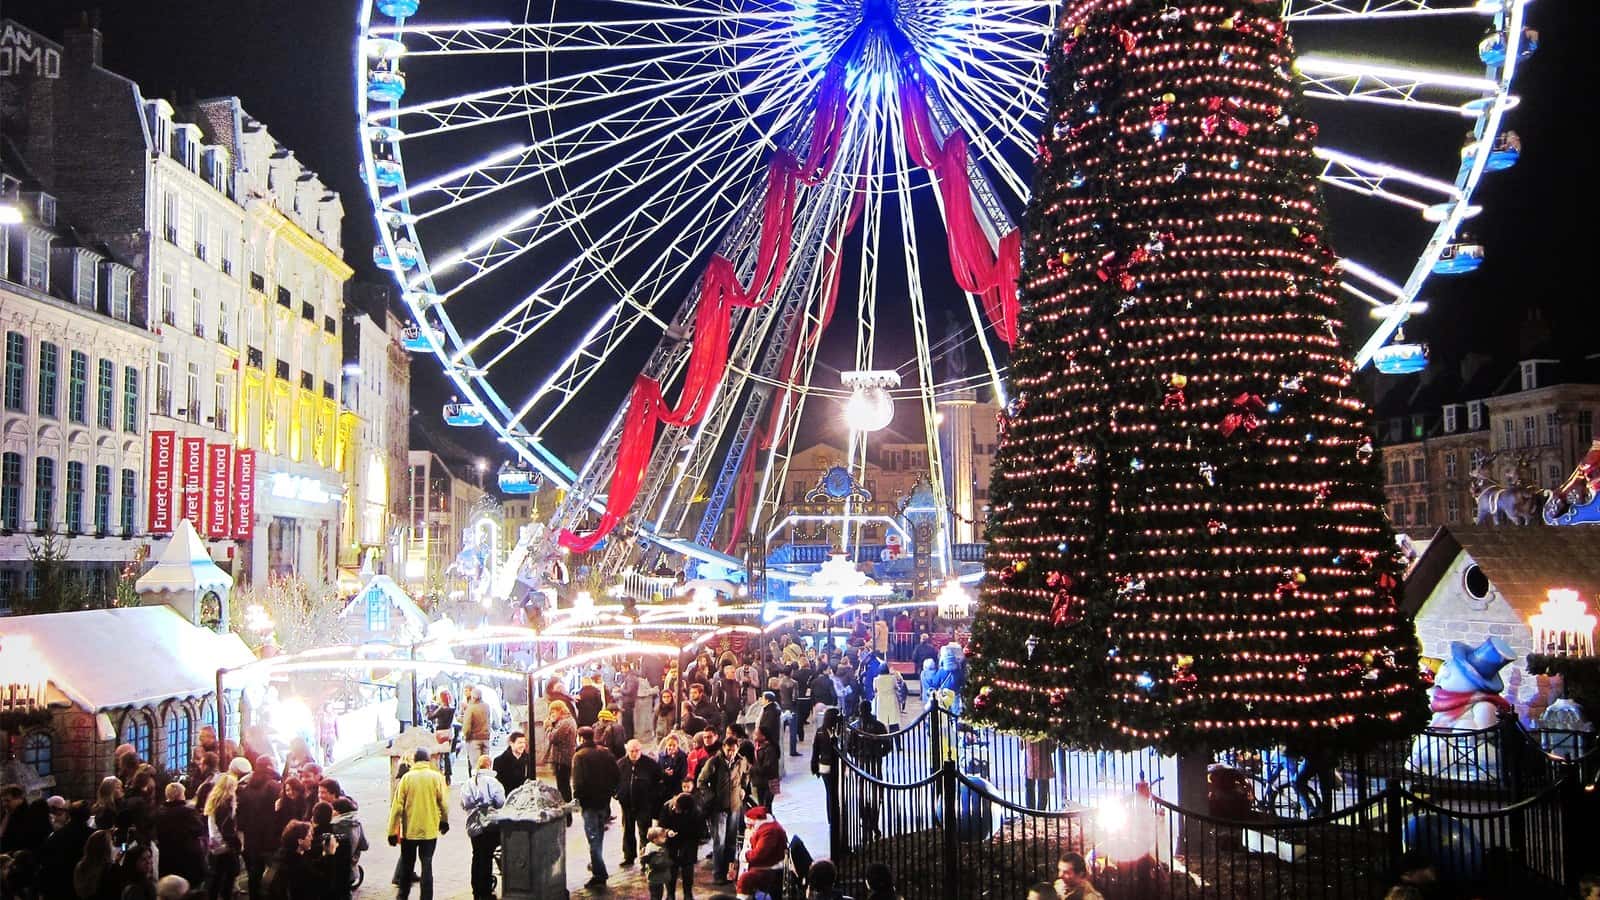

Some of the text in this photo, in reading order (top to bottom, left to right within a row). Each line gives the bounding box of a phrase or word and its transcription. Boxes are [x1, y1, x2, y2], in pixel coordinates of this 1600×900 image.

[0, 25, 32, 48] AN
[154, 435, 170, 529] Furet du nord
[186, 441, 200, 524] uret du nord
[212, 448, 226, 533] Furet du nord
[238, 453, 252, 535] Furet du nord
